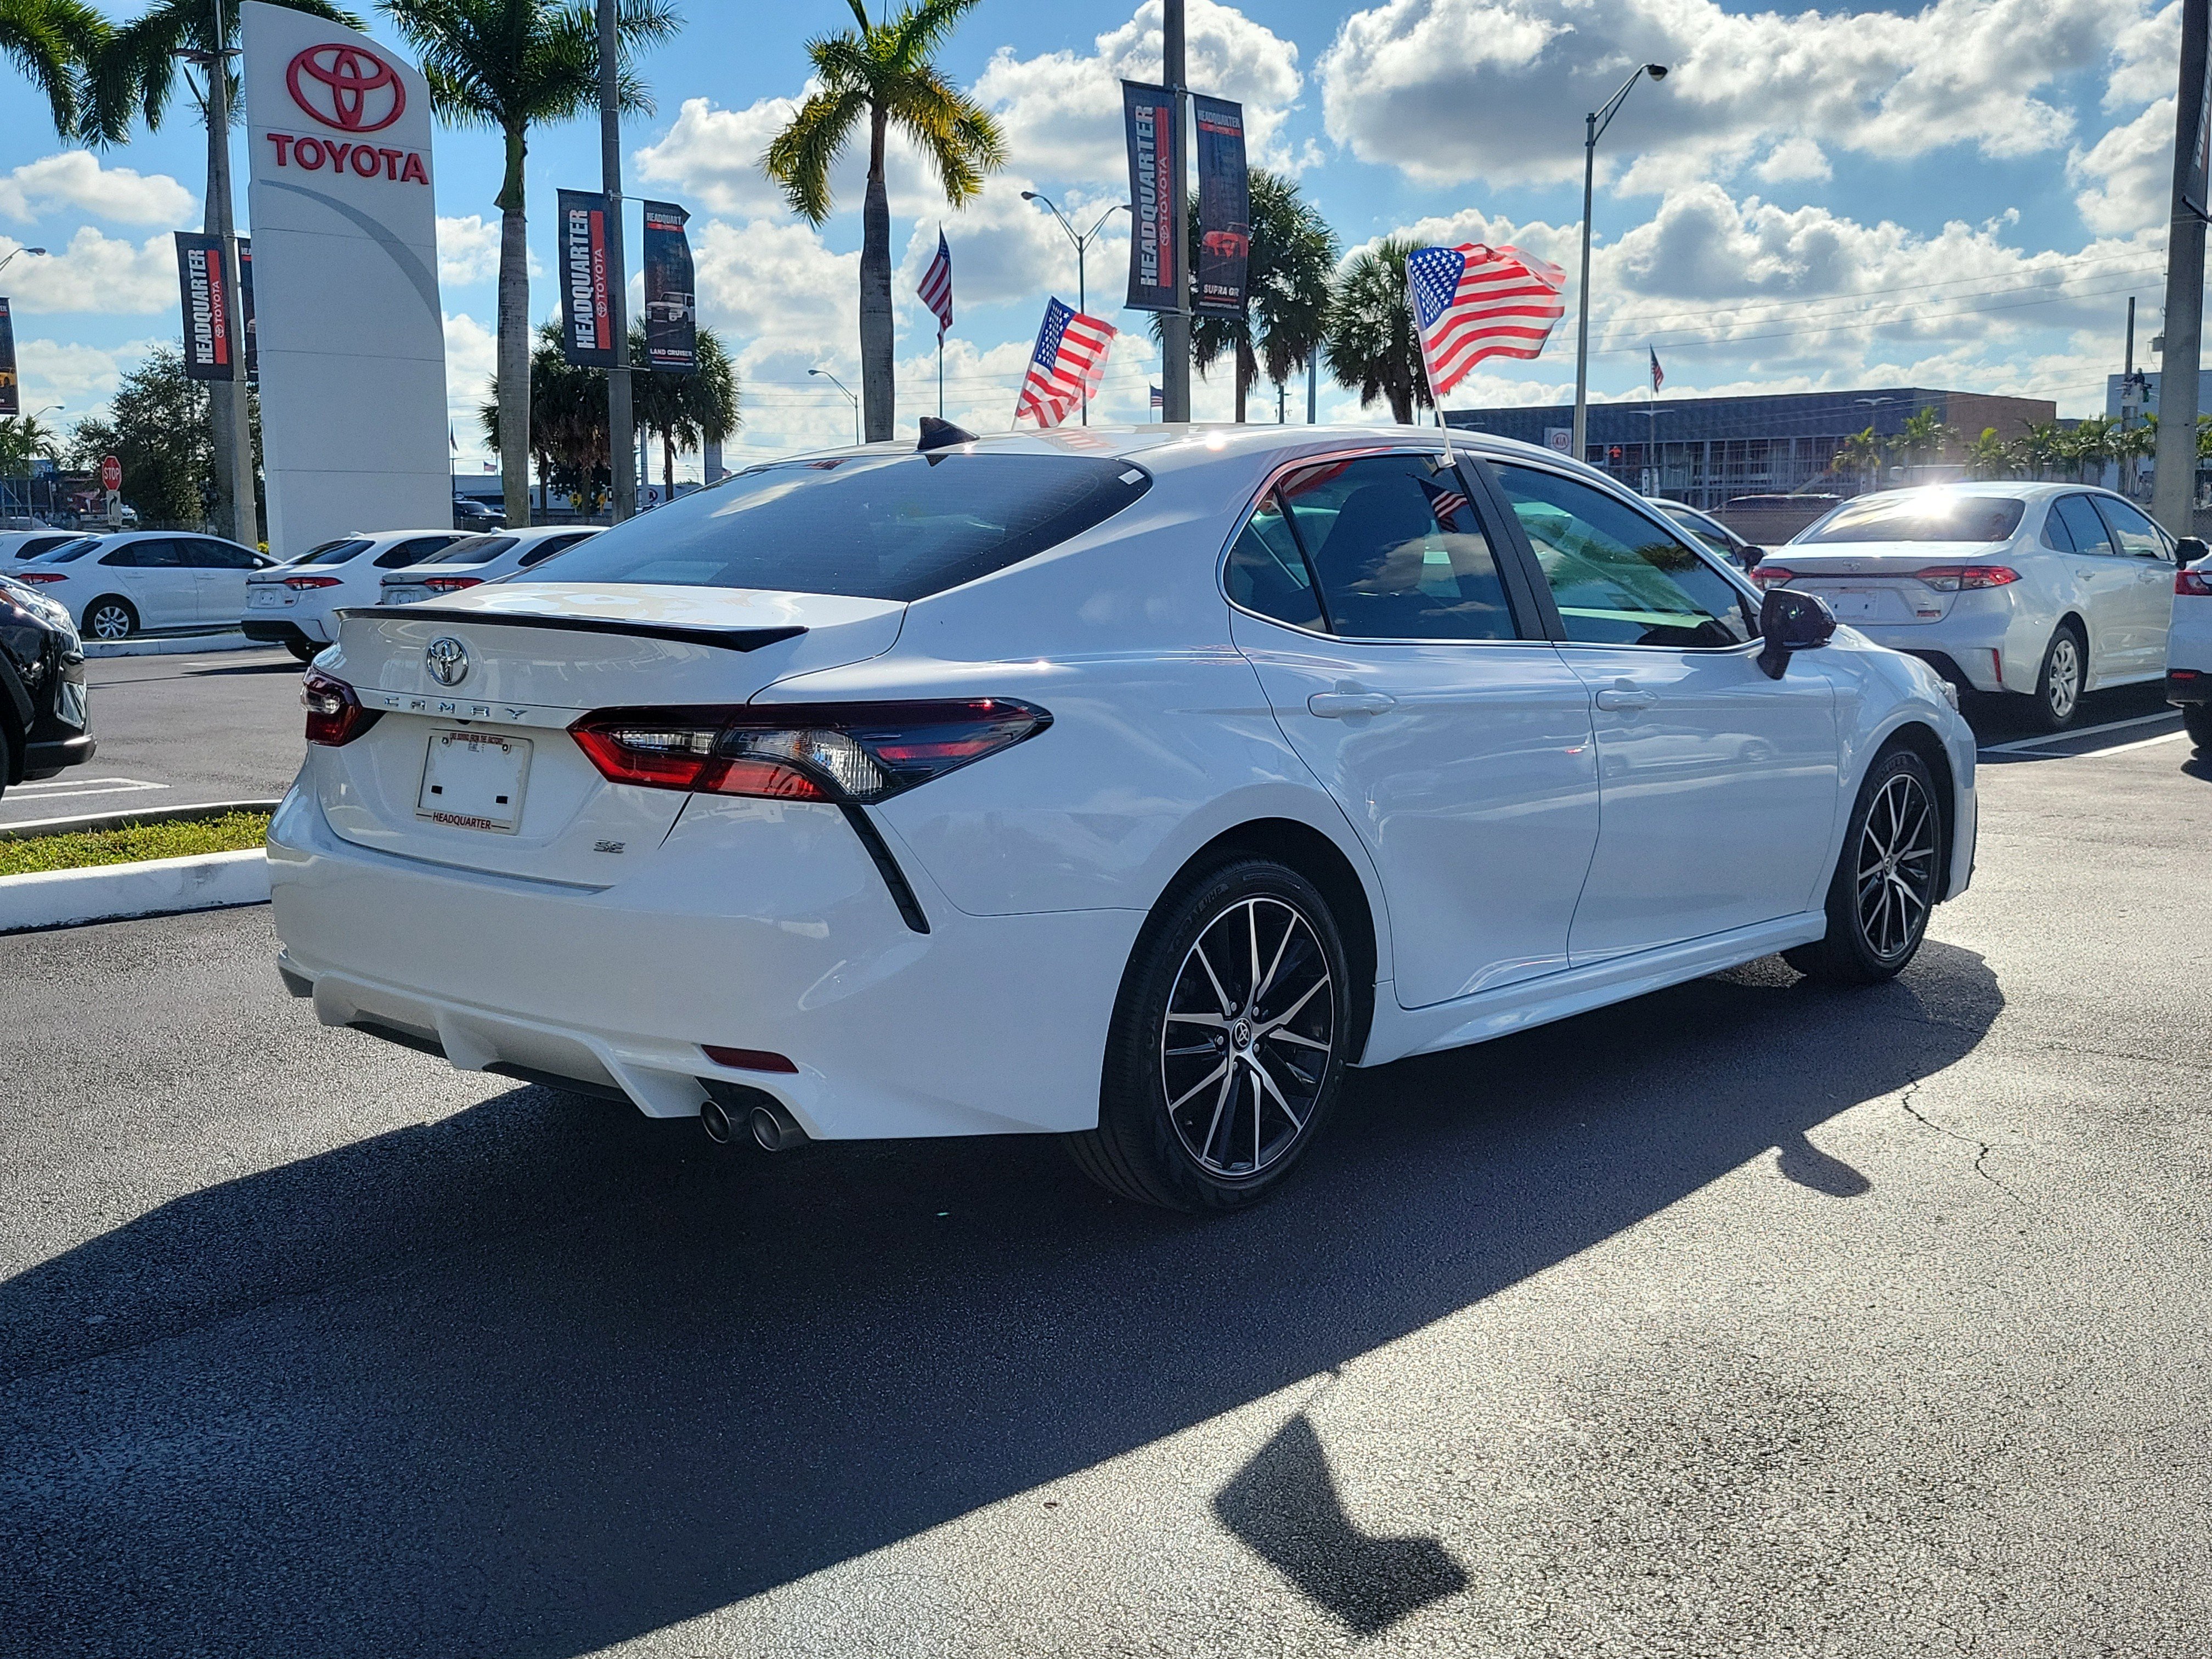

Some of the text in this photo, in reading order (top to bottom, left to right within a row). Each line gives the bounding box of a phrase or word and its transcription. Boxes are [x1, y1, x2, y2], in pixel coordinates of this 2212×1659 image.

[267, 133, 430, 185] TOYOTA
[1135, 105, 1158, 287] HEADQUARTER
[1159, 156, 1168, 223] TOYOTA
[647, 212, 684, 225] HEADQUART
[569, 209, 596, 349] HEADQUARTER
[594, 249, 605, 300] TOYOTA
[1203, 284, 1239, 296] SUPRA GR
[188, 249, 213, 364] HEADQUARTER
[212, 280, 223, 323] TOYOTA
[104, 467, 120, 480] STOP
[385, 697, 528, 719] CAMRY
[432, 812, 491, 829] HEADQUARTER
[594, 840, 625, 853] SE
